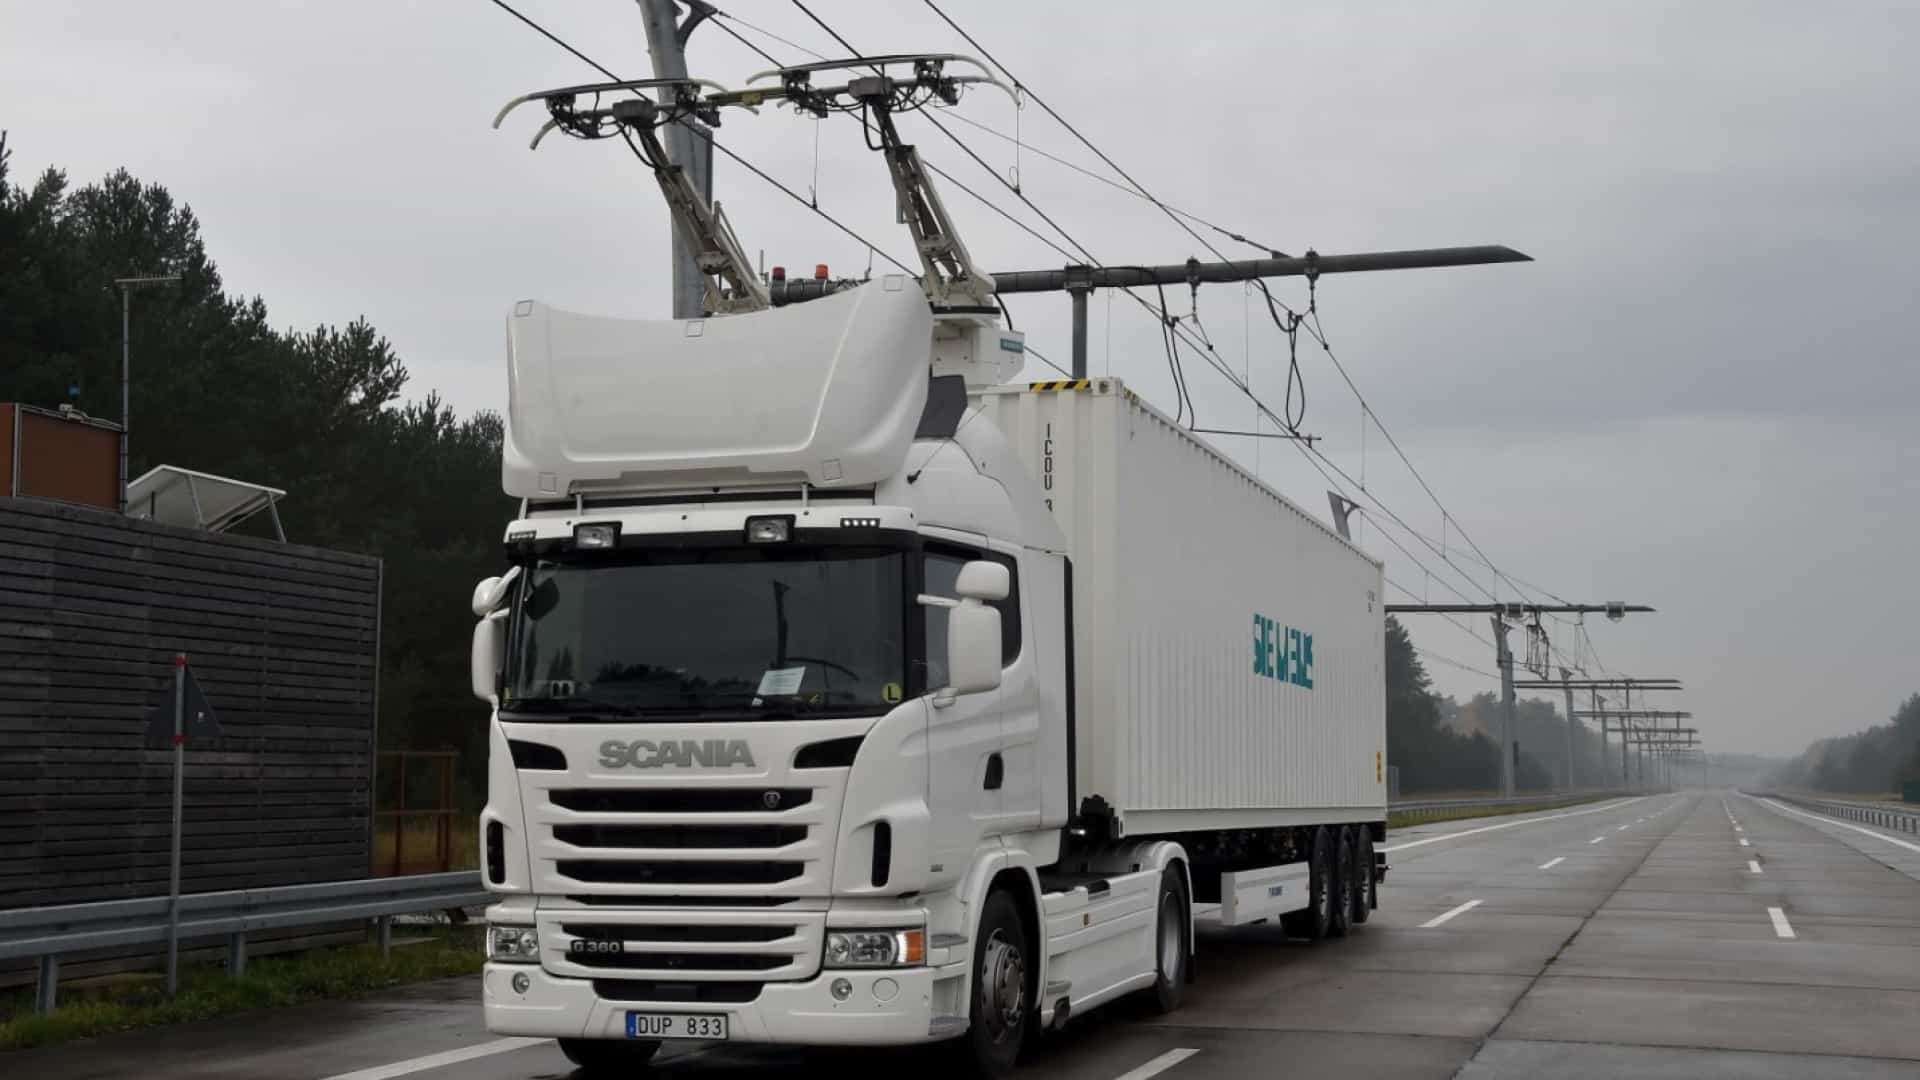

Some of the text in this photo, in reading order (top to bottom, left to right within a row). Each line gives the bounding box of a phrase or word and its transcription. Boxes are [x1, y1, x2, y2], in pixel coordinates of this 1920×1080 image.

[887, 684, 899, 701] L
[598, 739, 757, 769] SCANIA
[638, 1016, 673, 1034] DUP
[687, 1017, 722, 1036] 833
